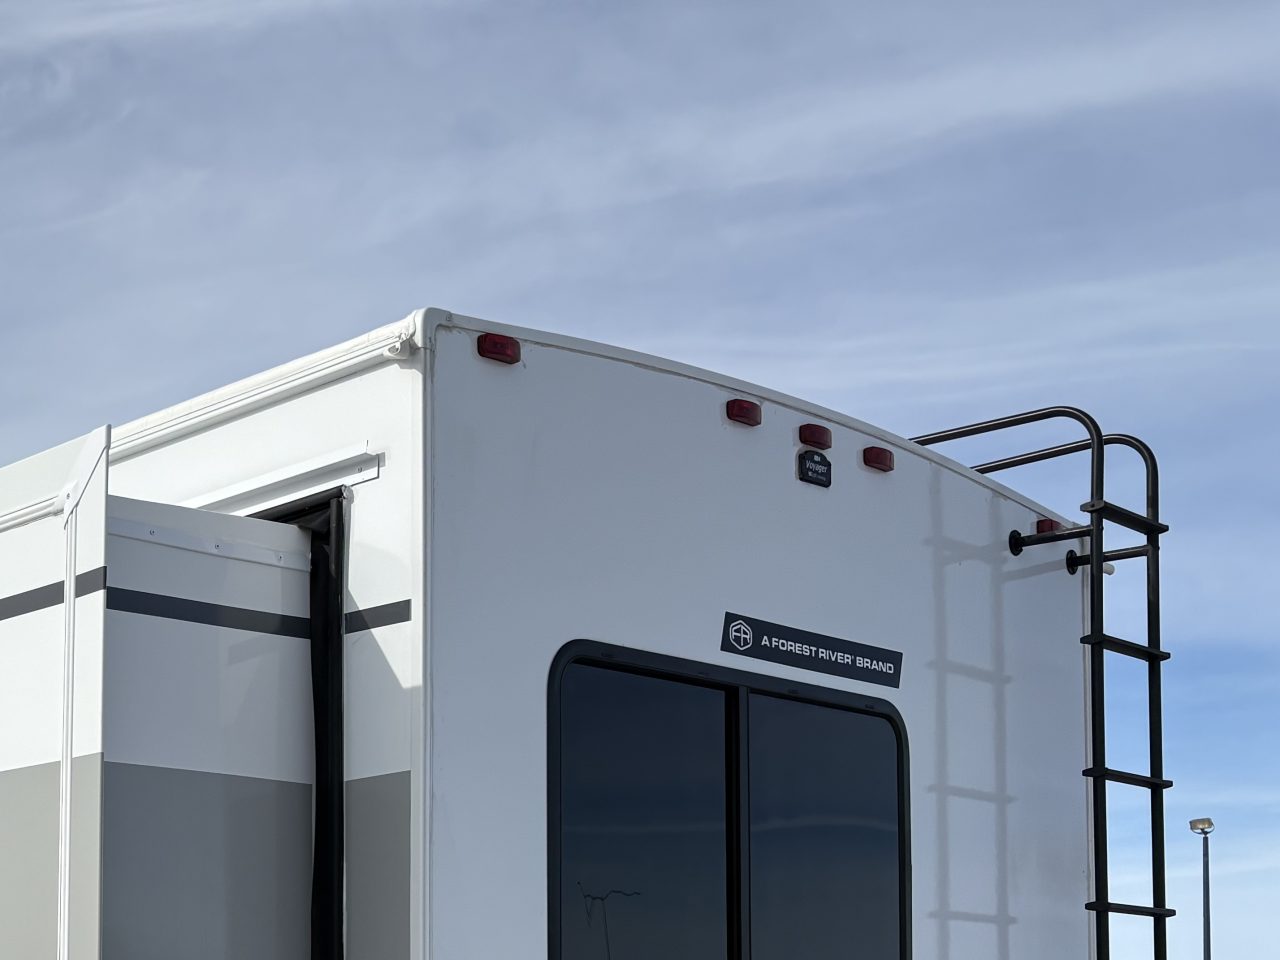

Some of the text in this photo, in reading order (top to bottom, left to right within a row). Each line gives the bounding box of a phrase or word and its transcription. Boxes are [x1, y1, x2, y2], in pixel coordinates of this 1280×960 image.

[806, 460, 827, 473] Voyager
[761, 635, 770, 647] A
[771, 637, 817, 658] FOREST
[856, 656, 894, 674] BRAND
